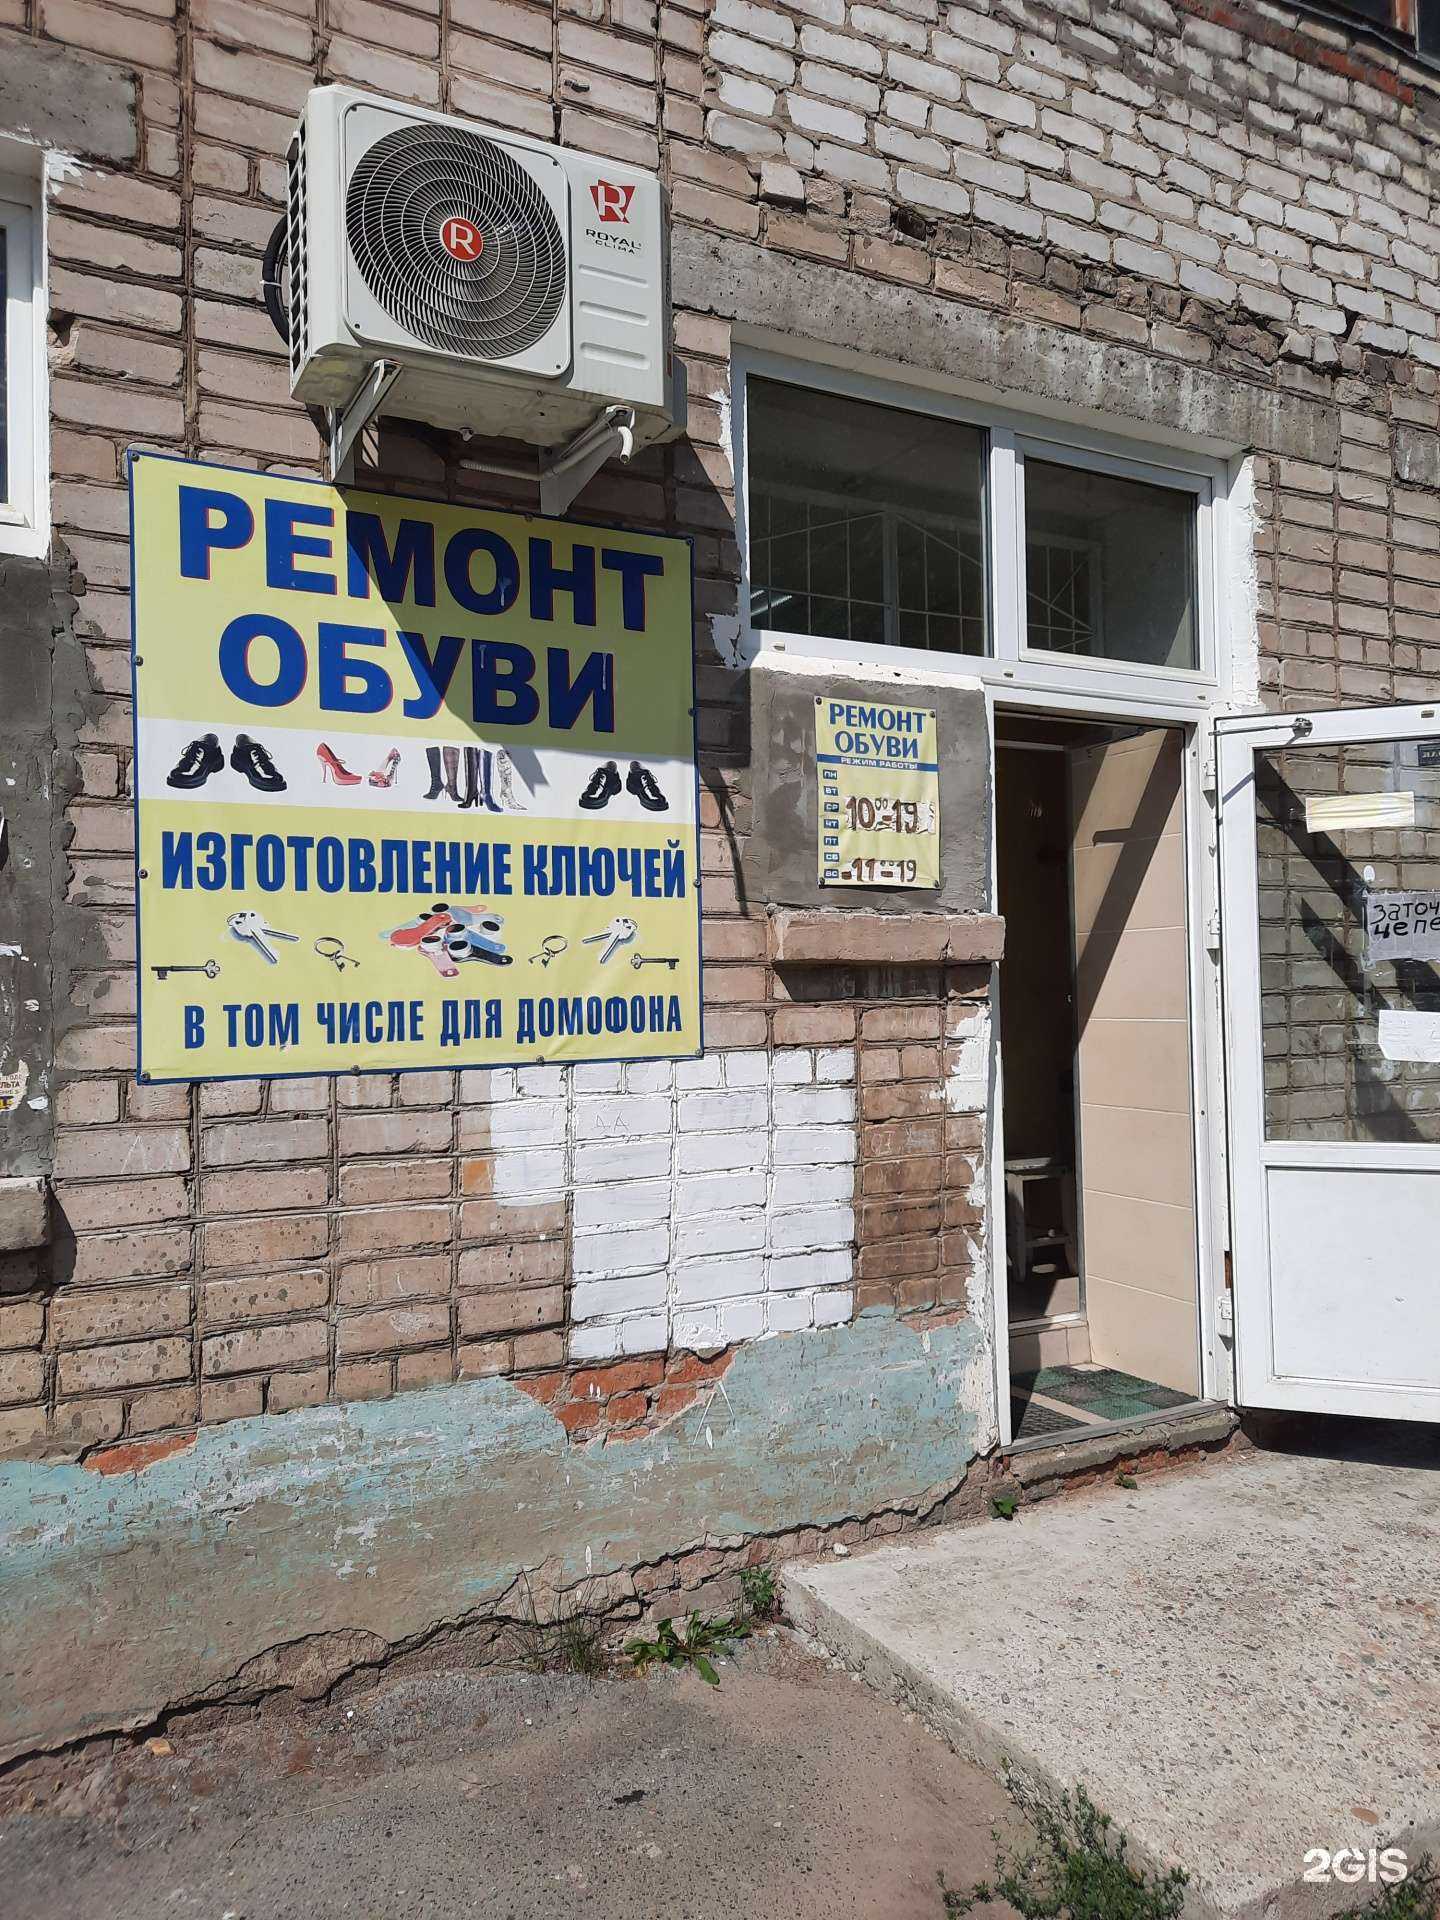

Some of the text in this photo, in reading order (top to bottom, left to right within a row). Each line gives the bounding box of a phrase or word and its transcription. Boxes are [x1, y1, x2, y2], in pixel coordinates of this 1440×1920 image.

[450, 222, 476, 256] R
[585, 228, 642, 250] ROYAL
[595, 239, 635, 255] CLIMA
[178, 485, 664, 632] РЕМОНТ
[218, 613, 615, 734] ОБУВИ
[829, 703, 926, 733] РЕМОНТ
[834, 730, 919, 760] ОБУВИ
[840, 756, 918, 770] РЕЖИМ РАБОТЫ
[162, 831, 686, 898] ИЗГОТОВЛЕНИЕ КЛЮЧЕЙ
[184, 995, 682, 1049] В ТОМ ЧИСЛЕ ДЛЯ ДОМОФОНА
